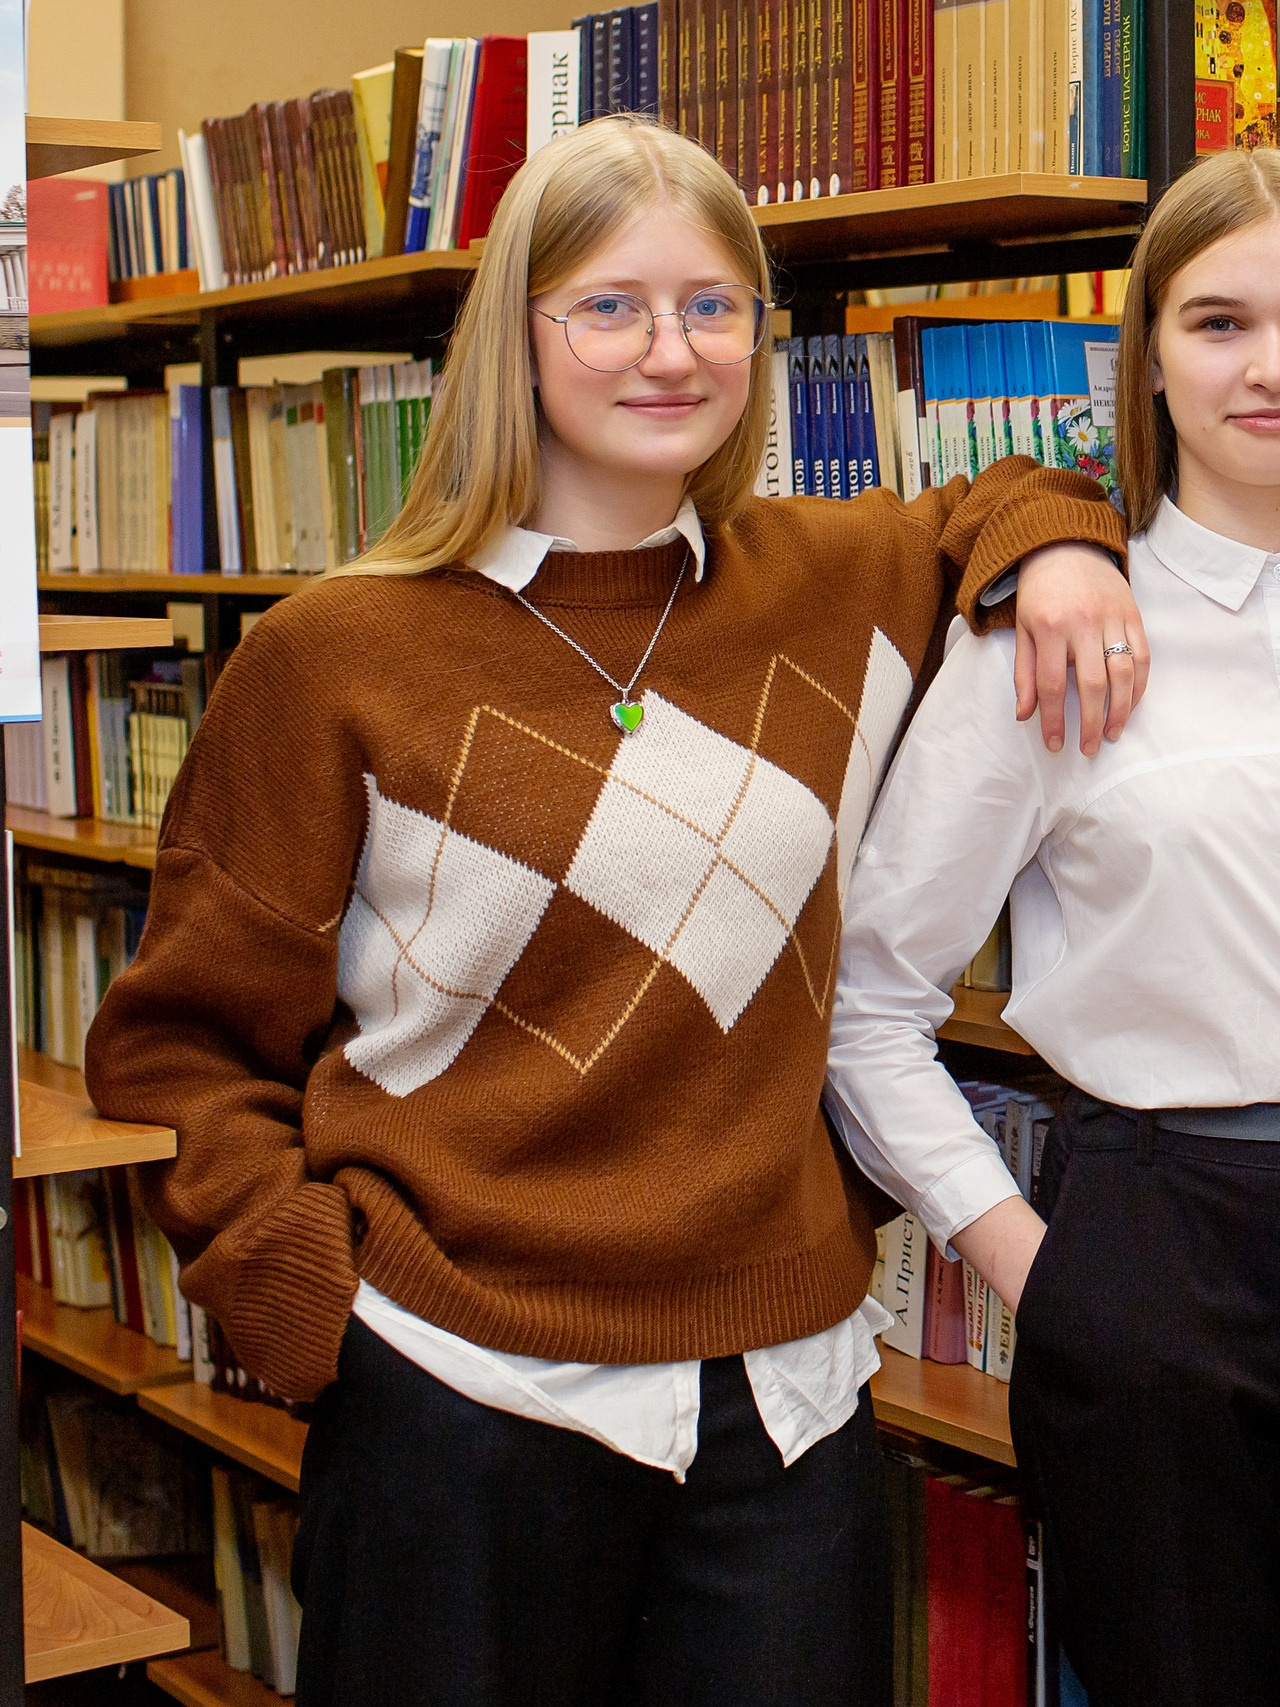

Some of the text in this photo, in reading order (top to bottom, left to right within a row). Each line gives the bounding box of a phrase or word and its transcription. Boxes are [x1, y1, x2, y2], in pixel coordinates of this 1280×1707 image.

[1071, 38, 1080, 75] Борис
[1103, 32, 1112, 78] БОРИС
[1112, 29, 1121, 75] БОРИС
[1122, 14, 1132, 154] БОРИС ПАСТЕРНАК
